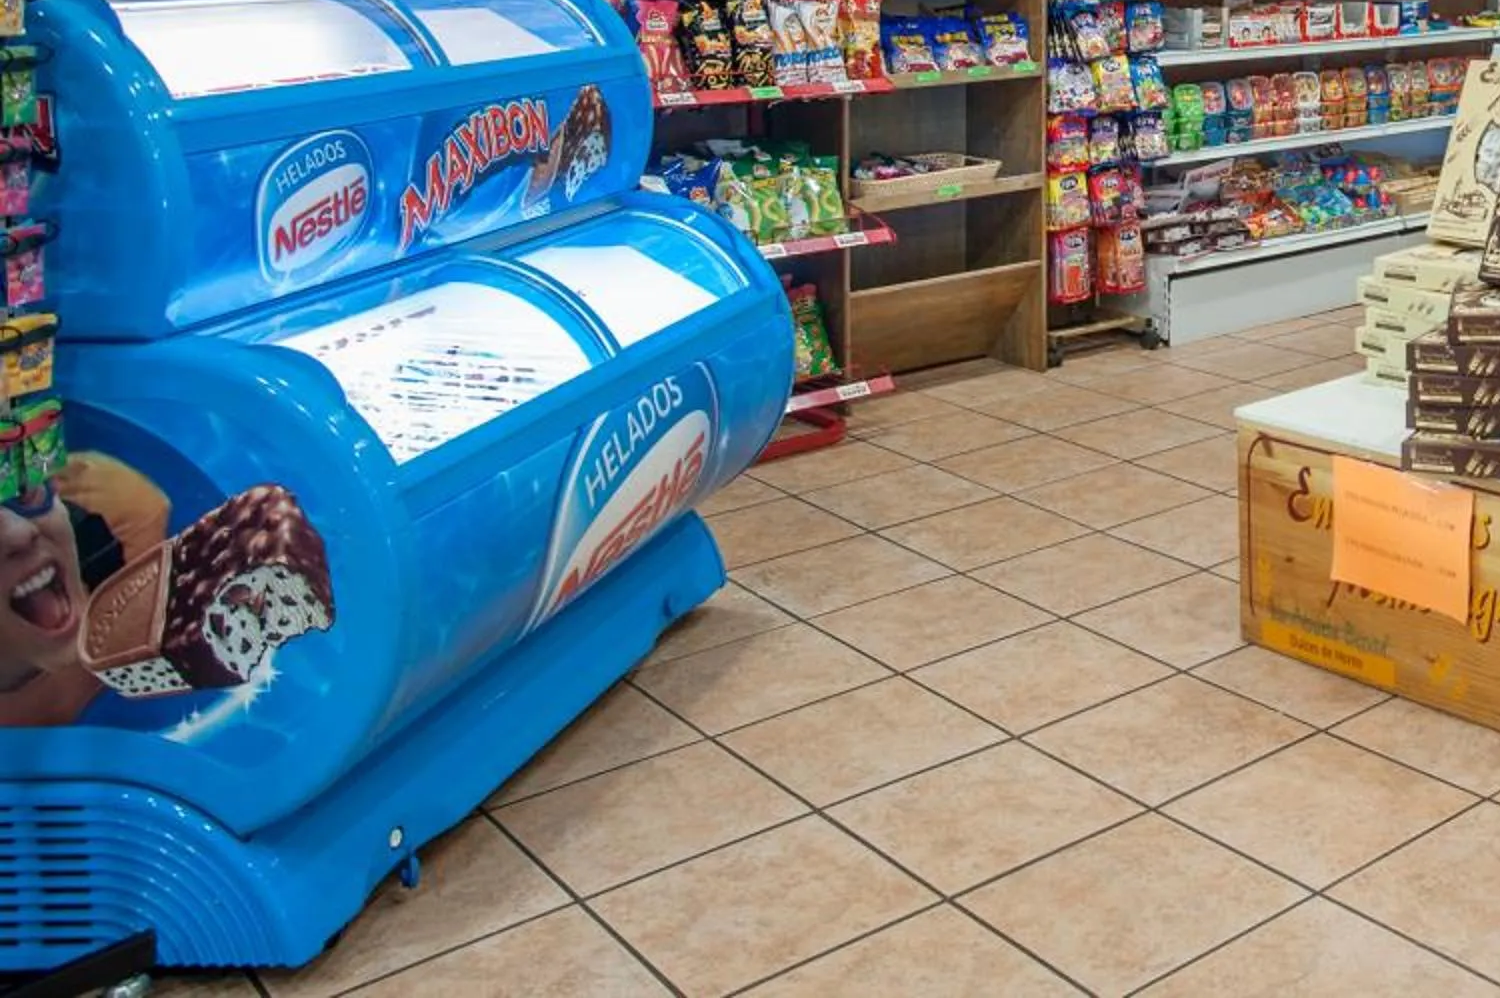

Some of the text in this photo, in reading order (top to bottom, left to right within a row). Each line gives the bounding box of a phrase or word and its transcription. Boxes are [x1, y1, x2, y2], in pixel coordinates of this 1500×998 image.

[275, 139, 347, 195] HELADOS
[400, 97, 551, 252] MAXIBON
[584, 375, 684, 507] HELADOS
